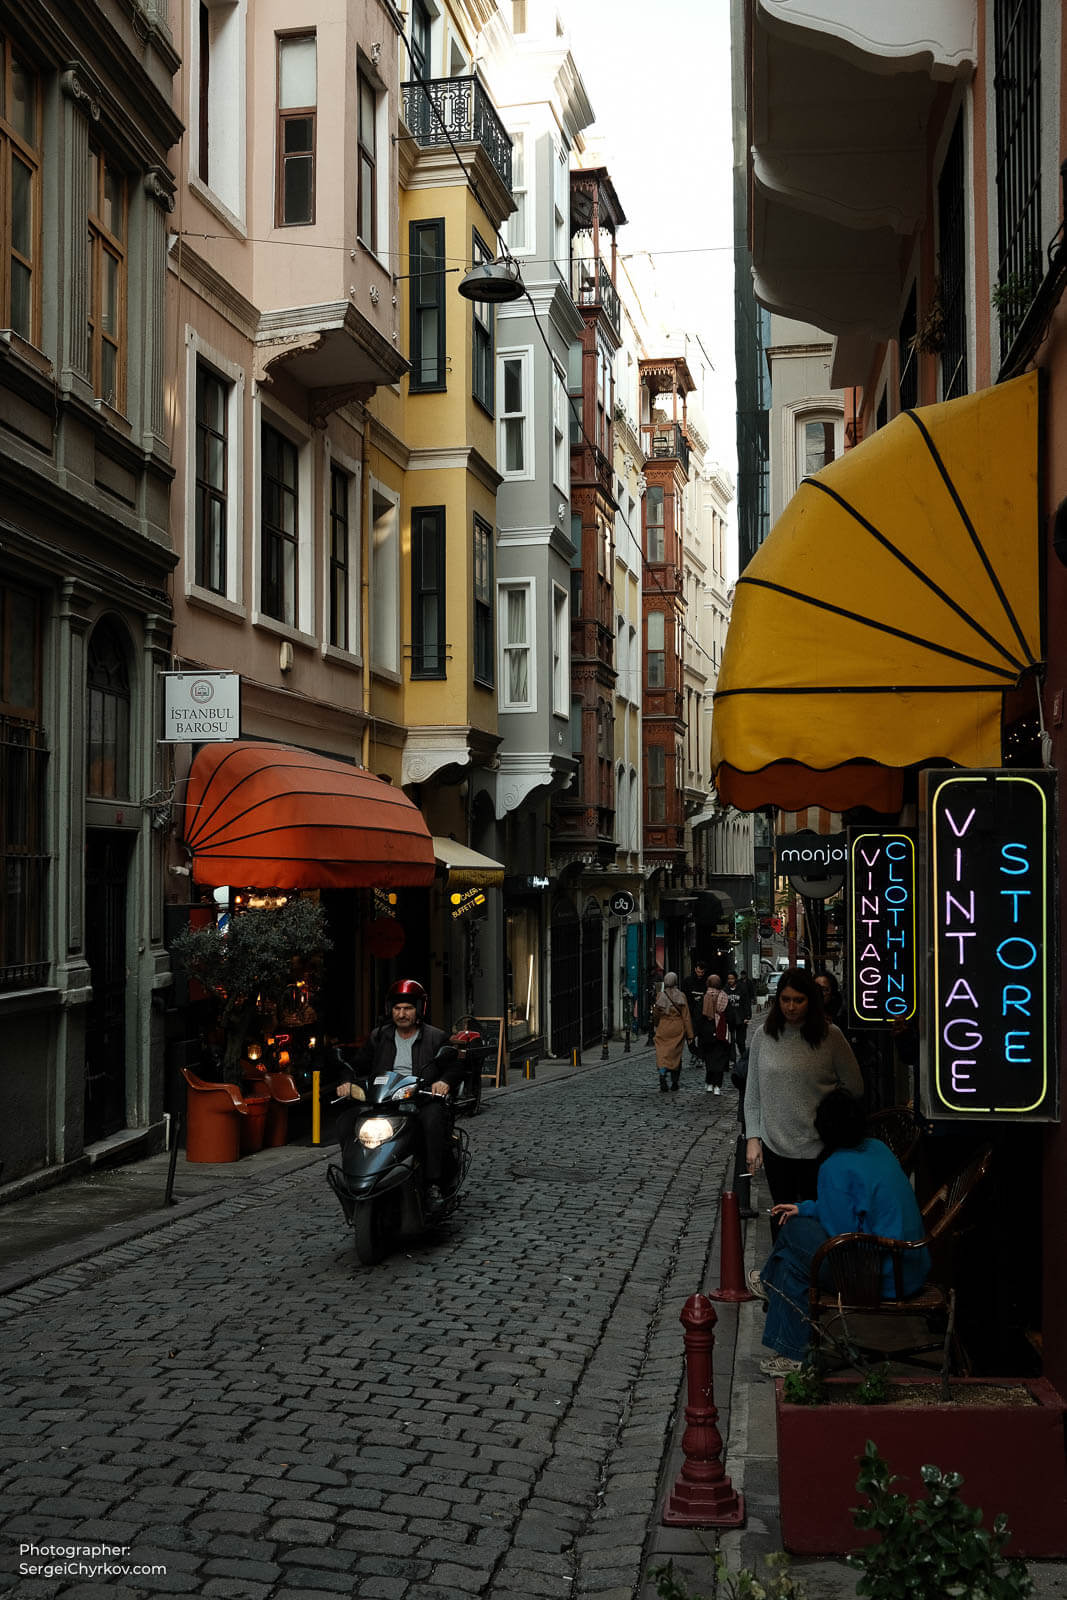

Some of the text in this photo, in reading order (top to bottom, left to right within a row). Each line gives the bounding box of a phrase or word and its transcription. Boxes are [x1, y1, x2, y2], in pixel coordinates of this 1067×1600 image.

[171, 706, 233, 719] İSTANBUL
[176, 722, 228, 733] BAROSU
[781, 844, 848, 865] monjoi
[859, 849, 881, 1008] VINTAGE
[885, 841, 908, 1015] CLOTHING
[943, 808, 983, 1093] VINTAGE
[996, 843, 1037, 1063] STORE
